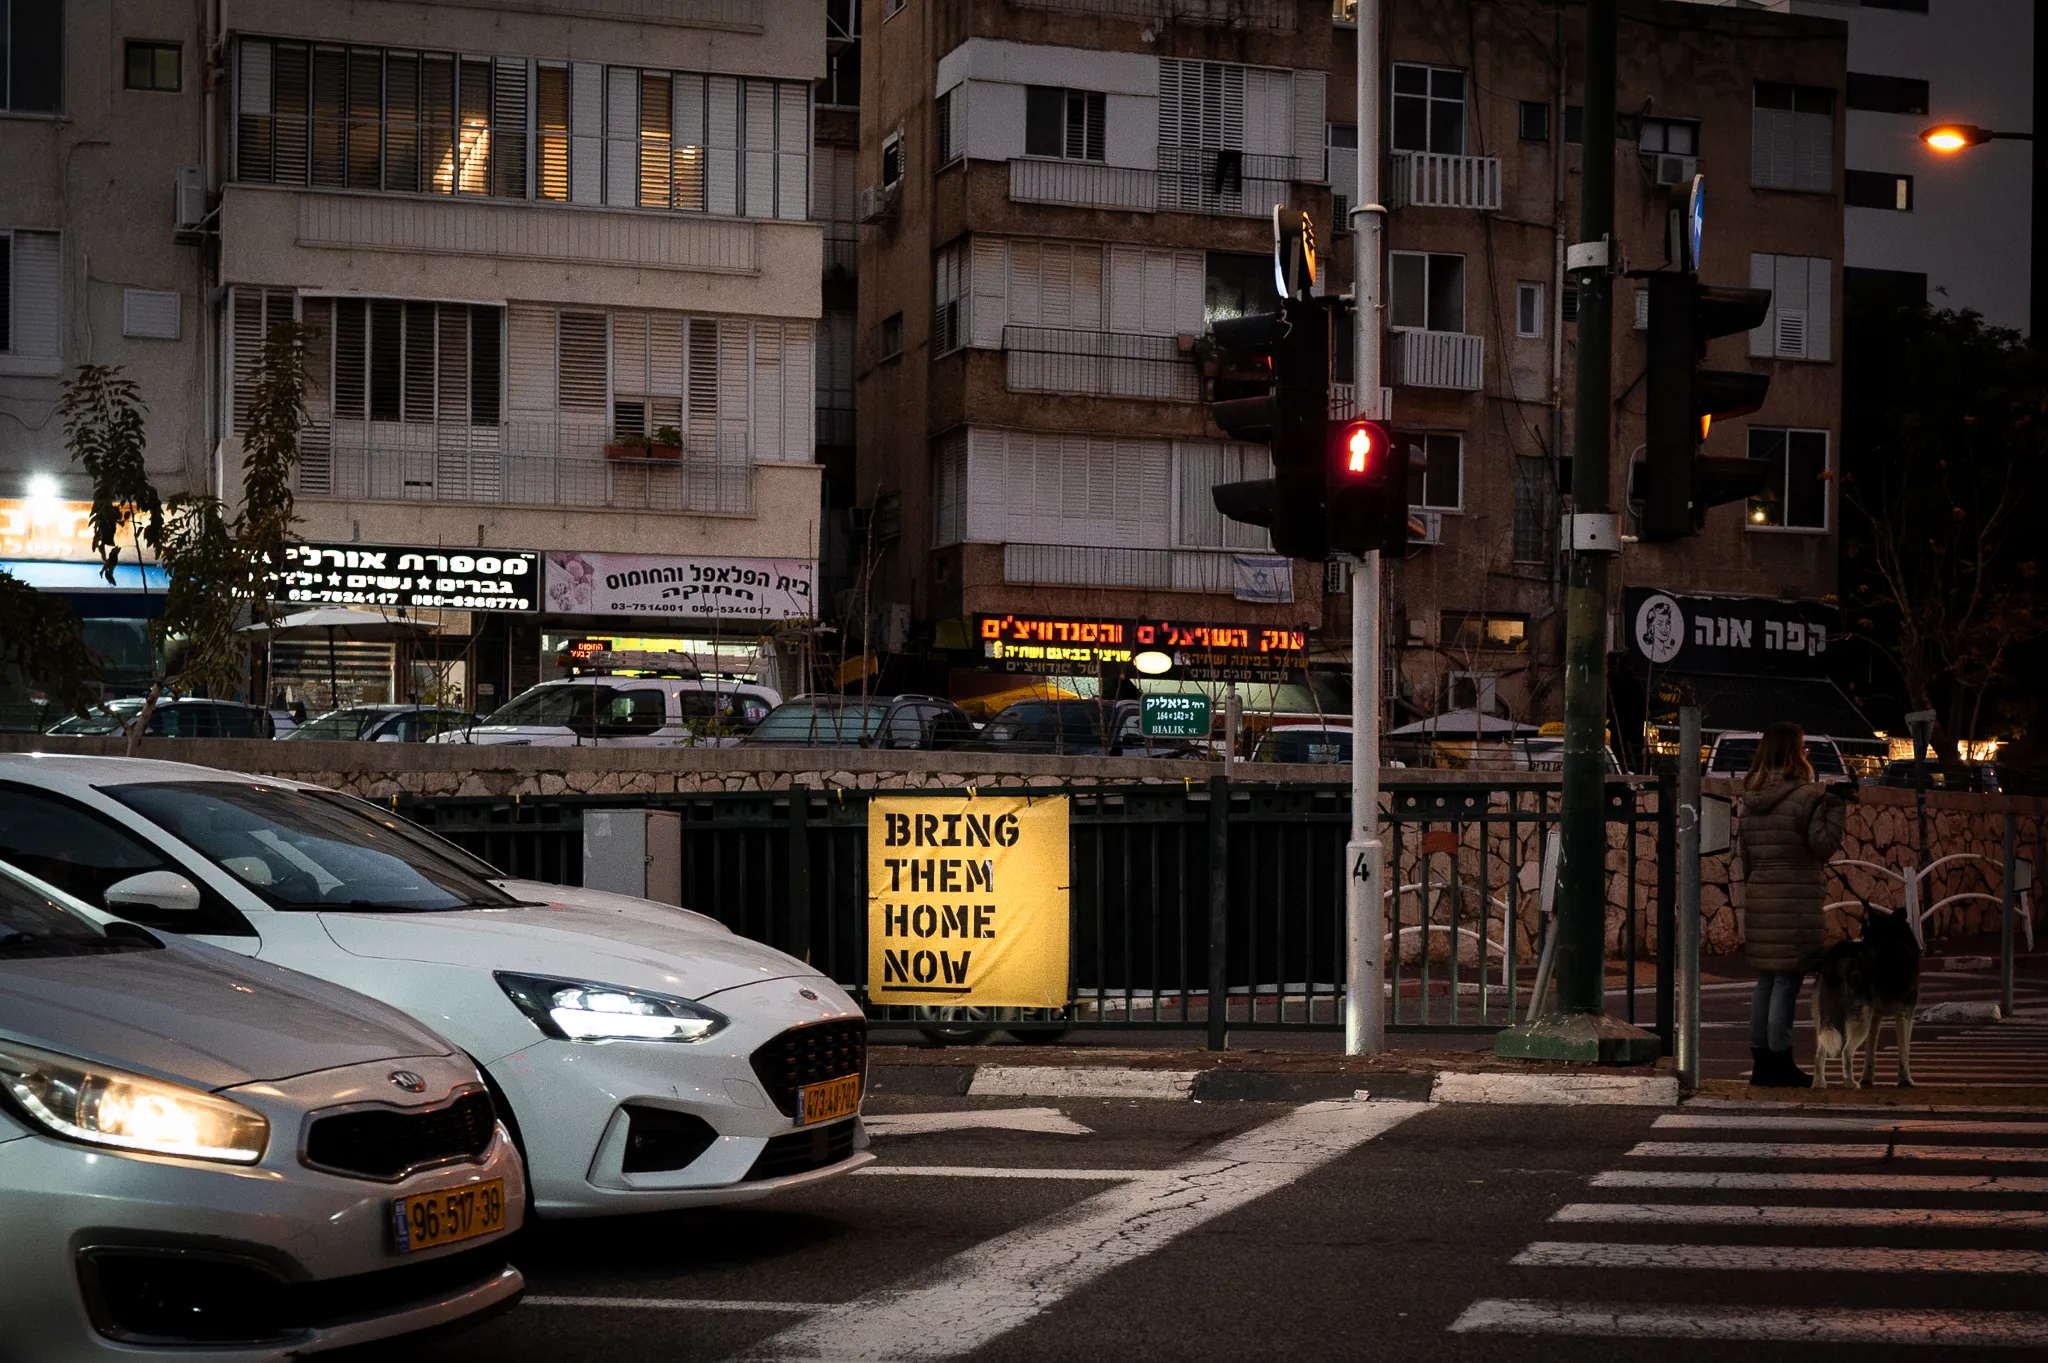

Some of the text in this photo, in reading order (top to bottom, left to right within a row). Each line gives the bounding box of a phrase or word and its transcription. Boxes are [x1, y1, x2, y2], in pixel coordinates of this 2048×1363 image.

[286, 545, 387, 569] אורלי
[397, 554, 528, 575] מספרת
[347, 574, 412, 590] נשים
[436, 578, 513, 594] גברים
[606, 564, 810, 597] בית הפלאפל והחומוס
[288, 588, 399, 606] 03-7524117
[611, 602, 771, 615] 03-7514001 050-5341017
[1260, 629, 1305, 653] ענק
[1695, 615, 1827, 656] קפה אנה
[1146, 696, 1190, 711] ביאליק
[1151, 725, 1184, 734] BIALIK
[885, 813, 1020, 847] BRING
[885, 859, 994, 893] THEM
[1352, 852, 1370, 884] 4
[885, 904, 996, 939] HOME
[885, 949, 972, 984] NOW
